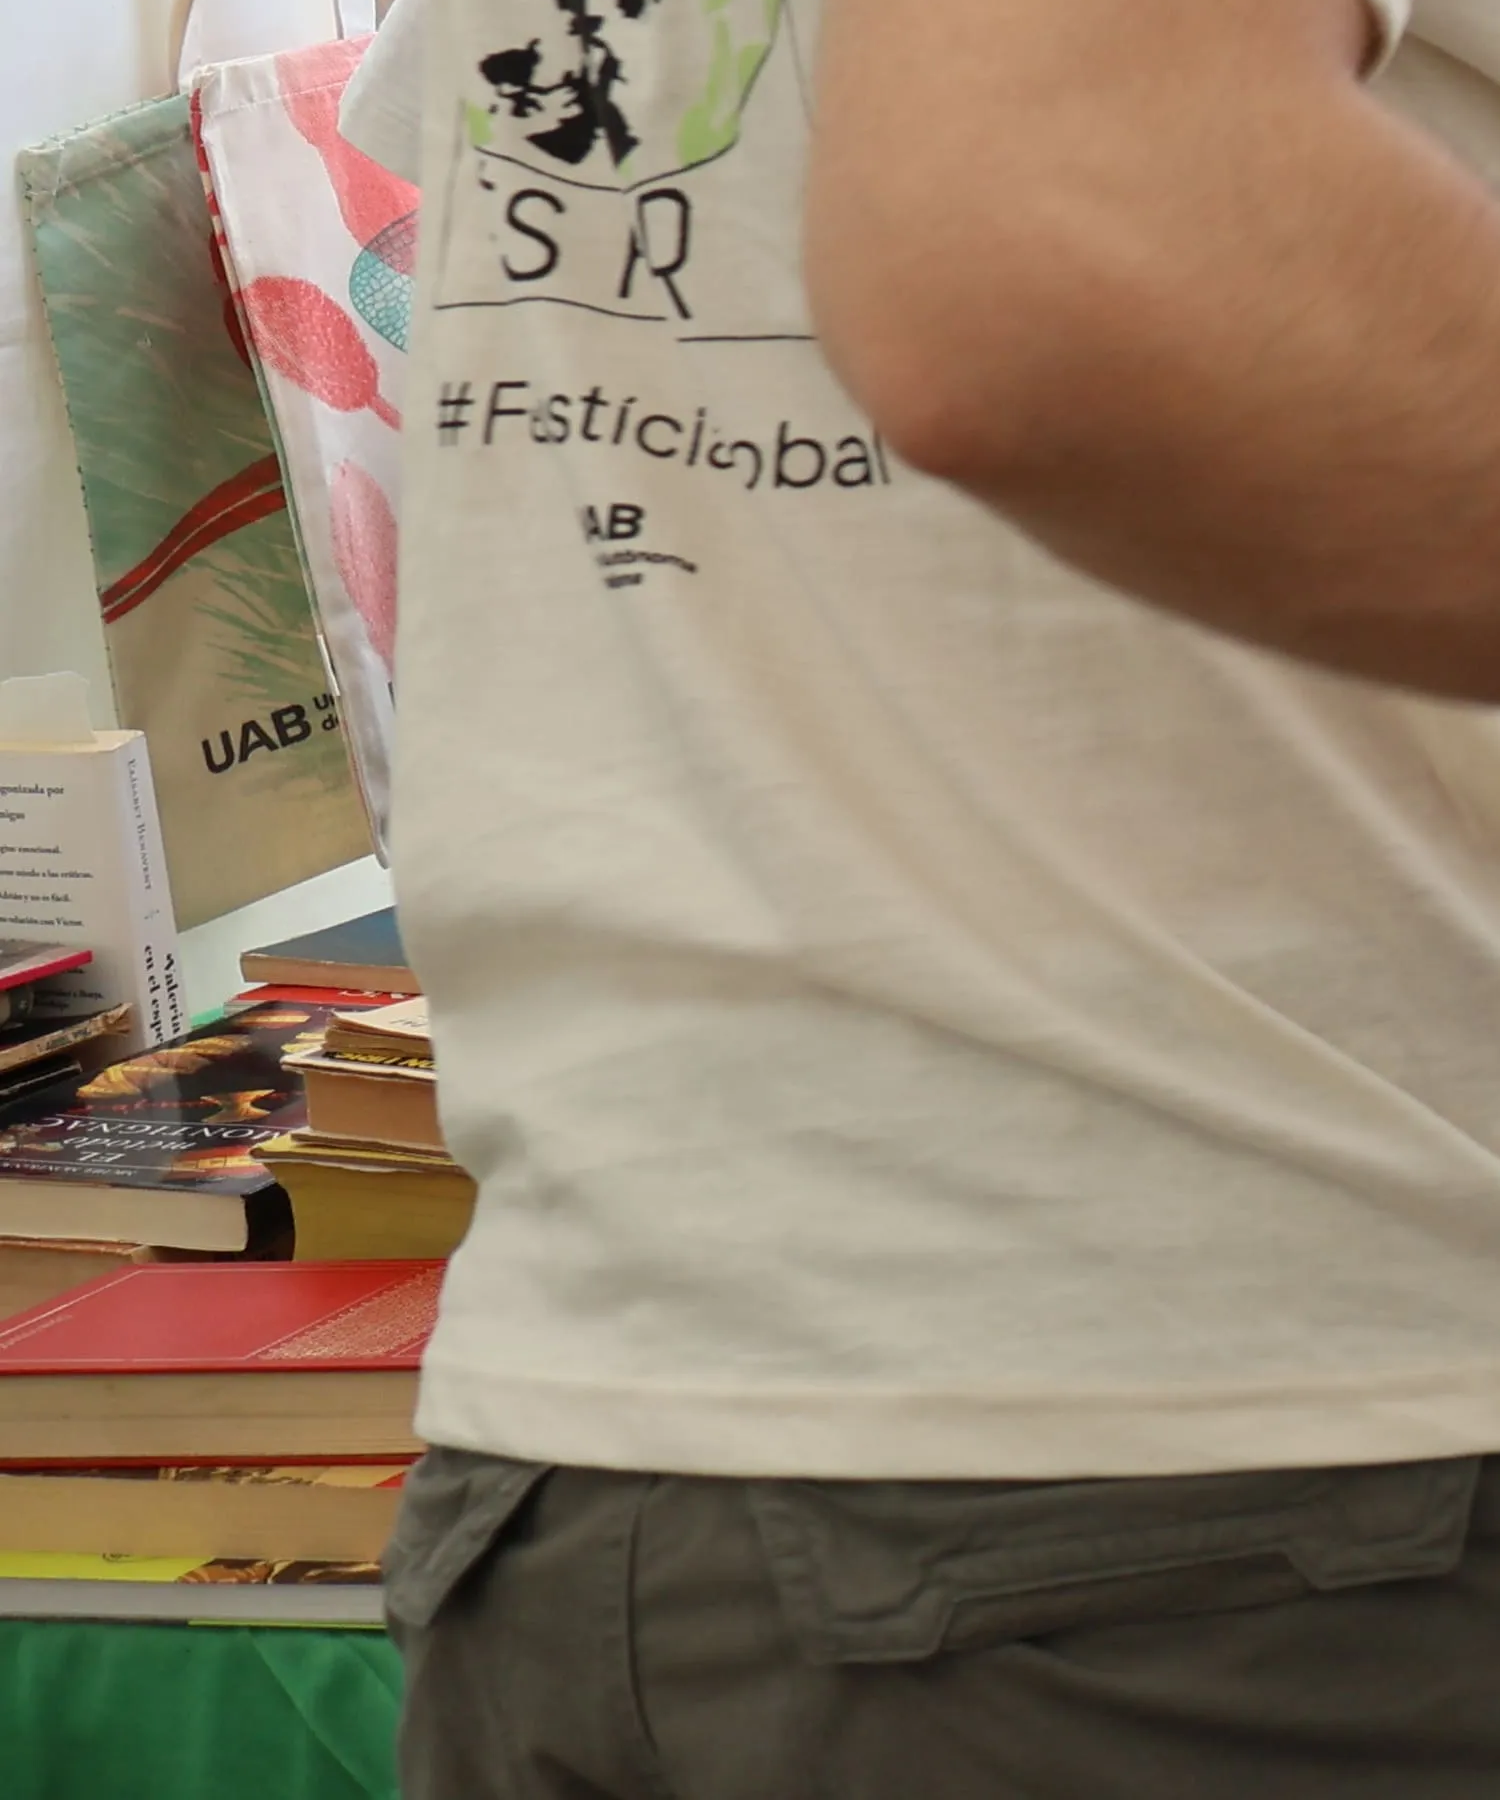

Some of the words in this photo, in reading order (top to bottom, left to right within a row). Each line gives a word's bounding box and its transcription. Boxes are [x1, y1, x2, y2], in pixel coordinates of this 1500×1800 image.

[202, 703, 312, 775] UAB
[63, 1135, 198, 1151] método
[77, 1151, 125, 1164] EL
